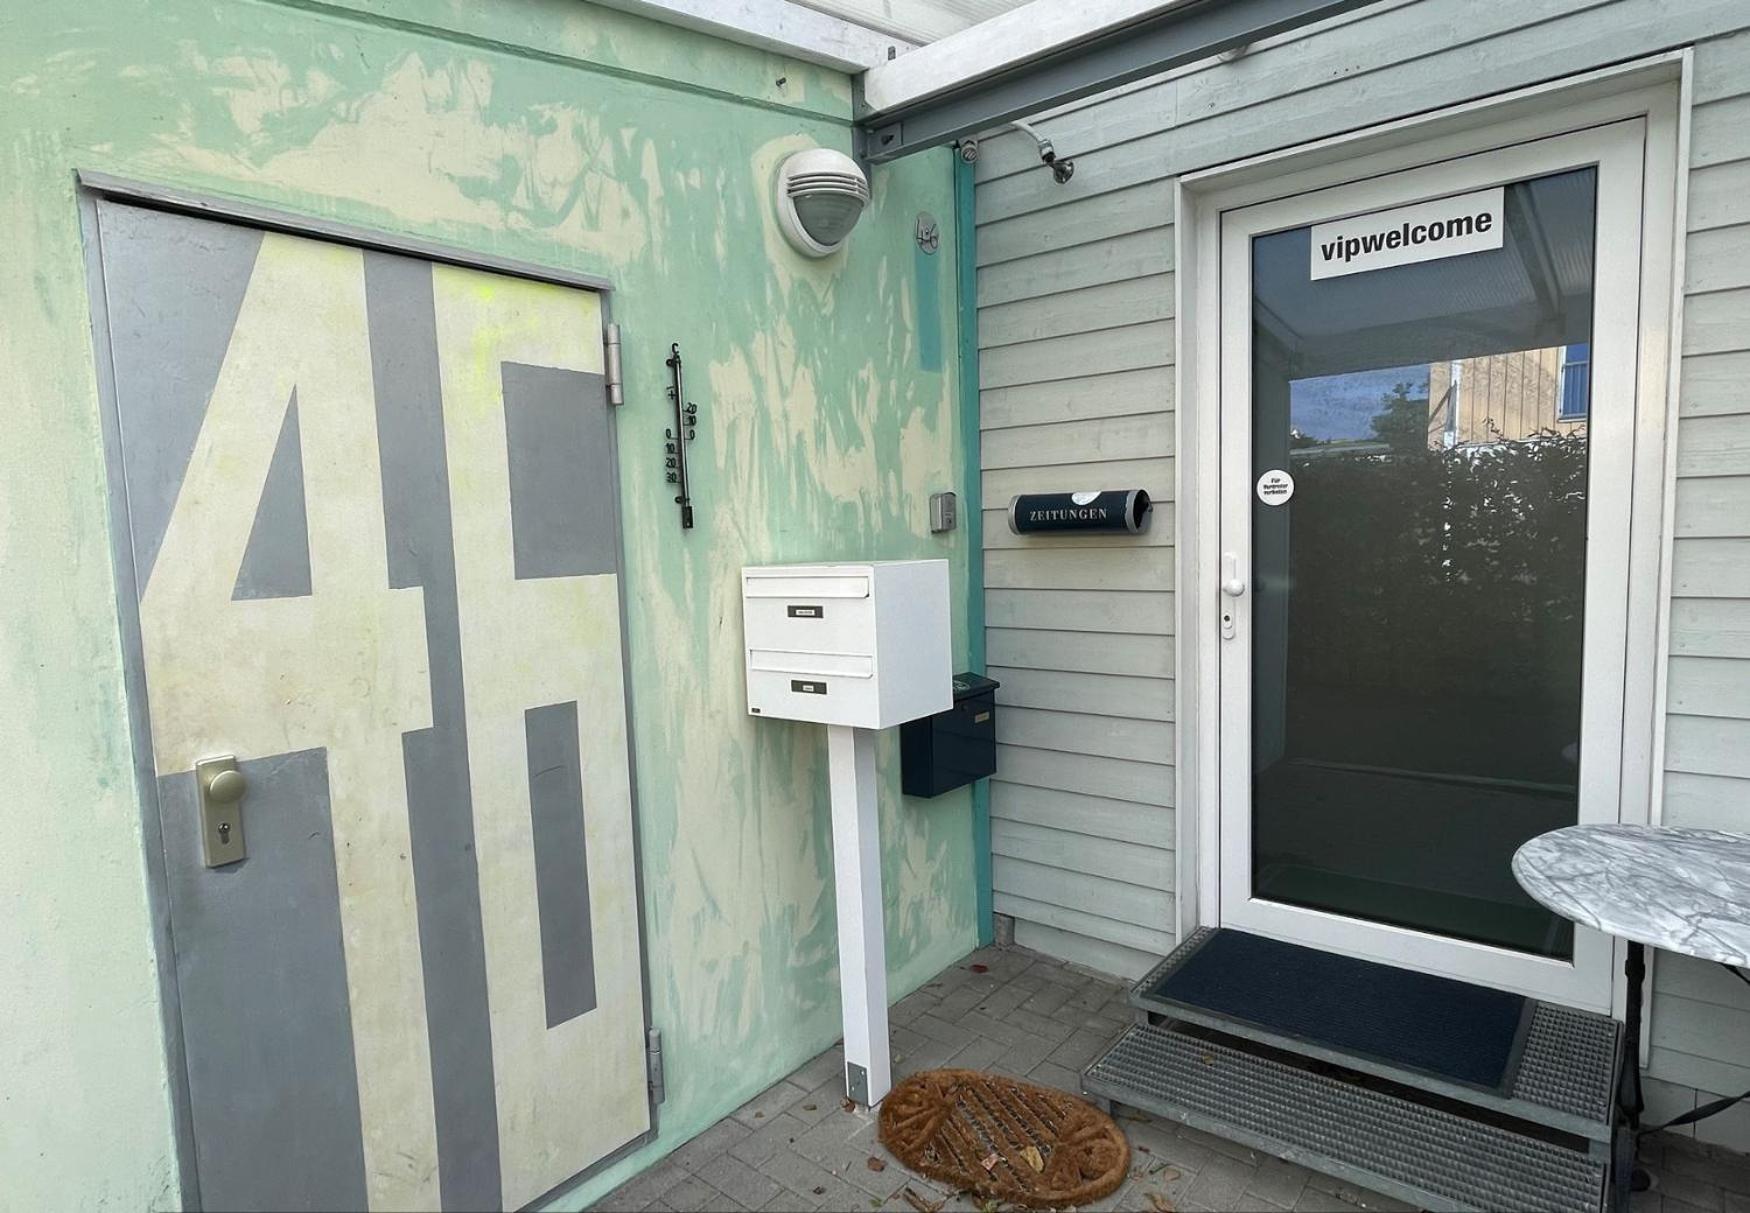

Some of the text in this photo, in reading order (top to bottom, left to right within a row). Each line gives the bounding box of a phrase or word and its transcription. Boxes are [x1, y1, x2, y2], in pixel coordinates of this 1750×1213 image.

[1321, 211, 1493, 263] vipwelcome
[687, 402, 698, 415] 20
[1029, 508, 1108, 522] ZEITUNGEN
[139, 232, 652, 1212] 46
